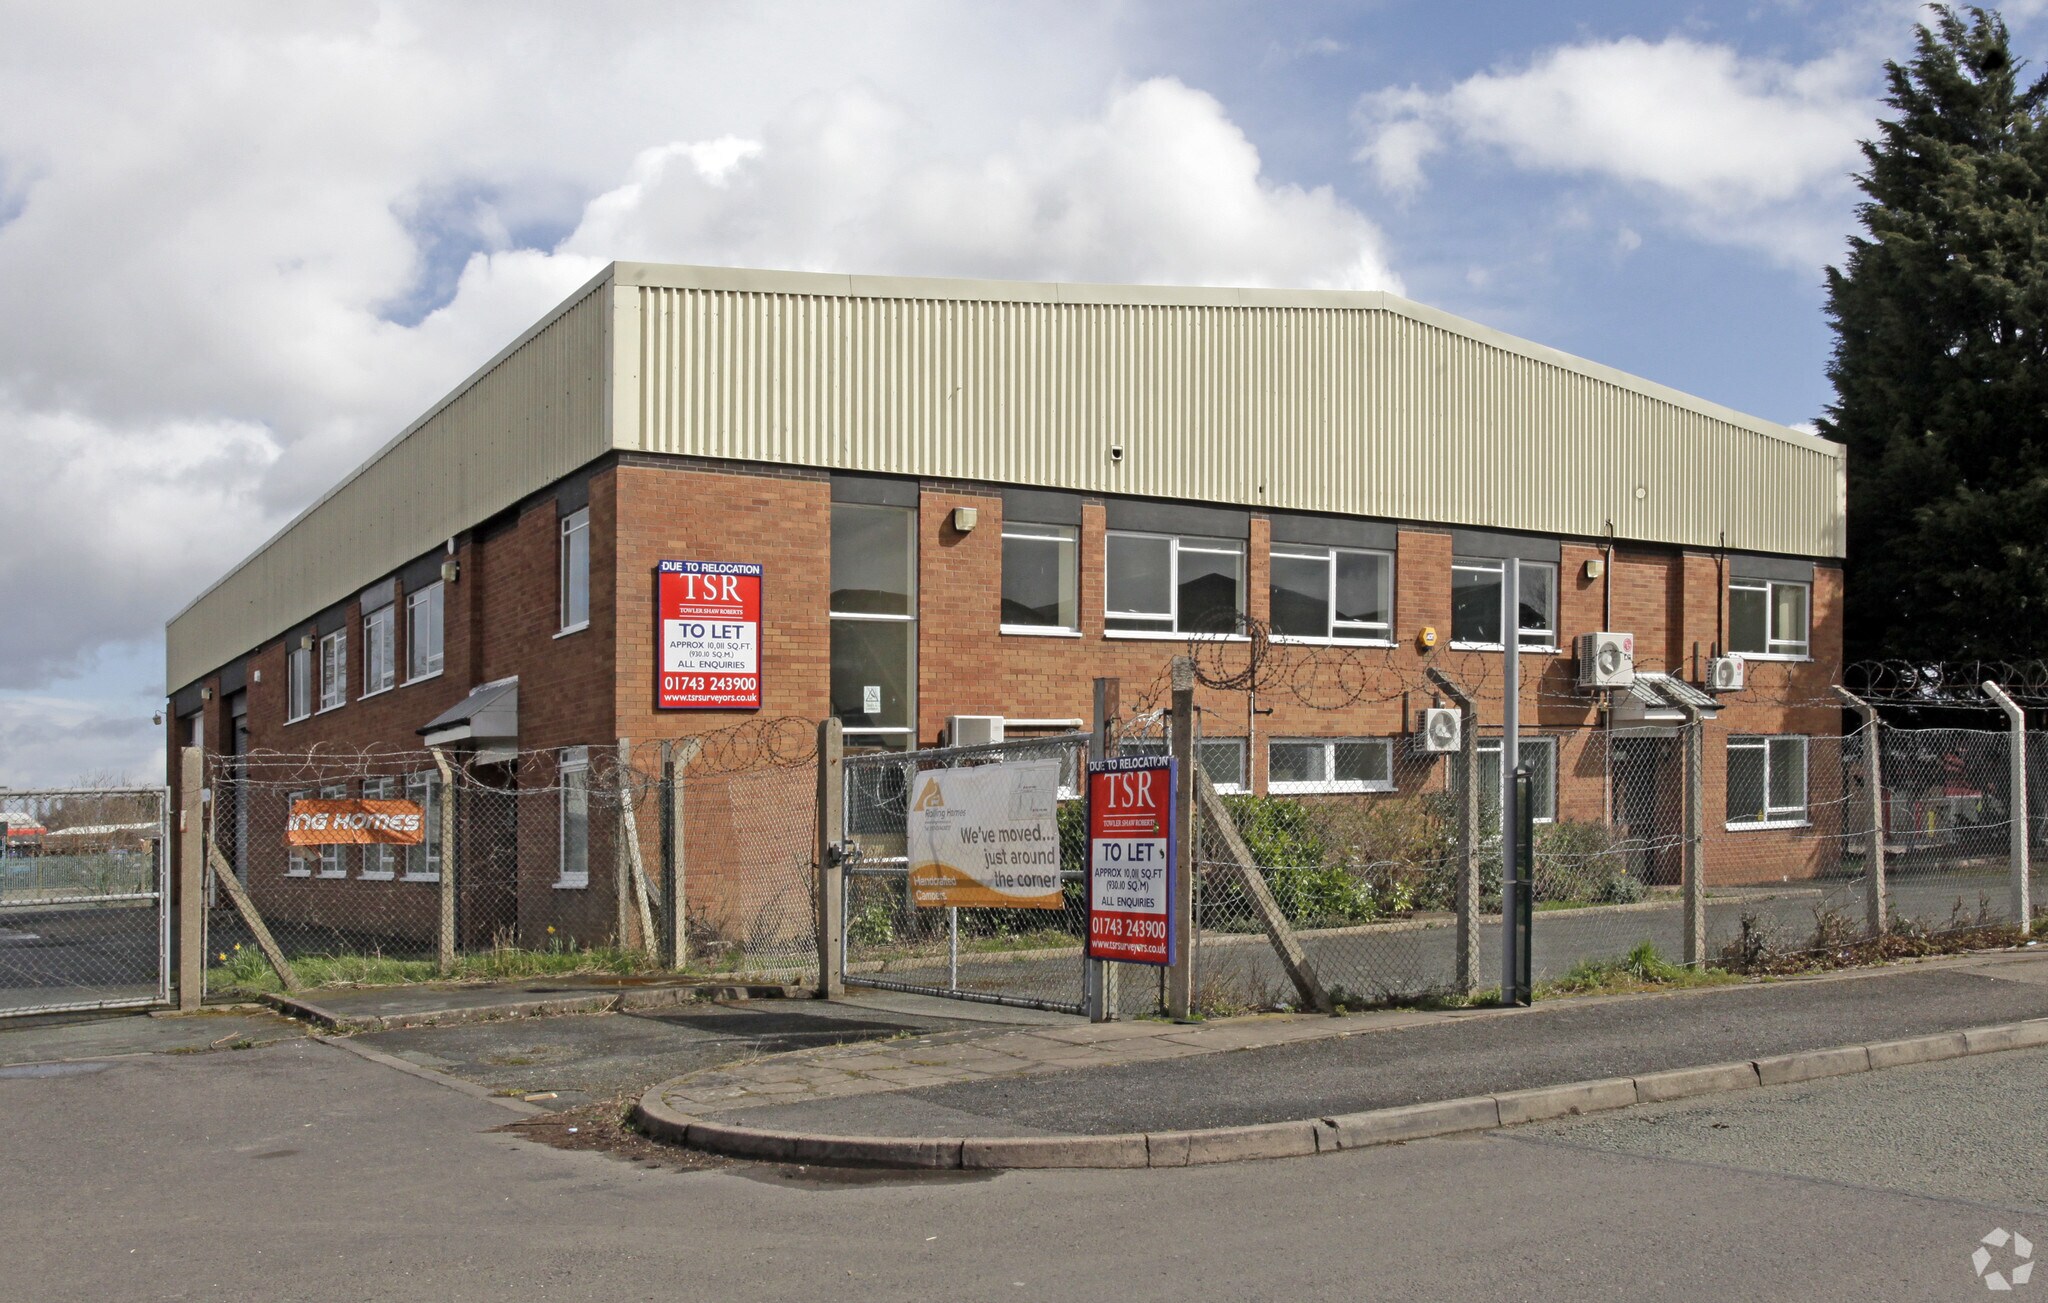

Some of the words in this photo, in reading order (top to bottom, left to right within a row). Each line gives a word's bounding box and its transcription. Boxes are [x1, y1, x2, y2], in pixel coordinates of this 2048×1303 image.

[662, 562, 682, 571] DUE
[686, 563, 699, 572] TO
[702, 564, 759, 574] RELOCATION
[680, 573, 743, 602] TSR
[679, 623, 705, 638] TO
[712, 625, 744, 639] LET
[670, 641, 704, 649] APPROX
[728, 643, 752, 651] SQ.FT.
[699, 661, 745, 669] ENQUIRIES
[665, 677, 704, 690] 01743
[710, 677, 756, 690] 243900
[664, 693, 756, 703] www.tsrsurveyors.co.uk
[1090, 761, 1105, 771] DUE
[1107, 760, 1117, 770] TO
[1120, 756, 1168, 770] RELOCATION
[1104, 771, 1155, 808] TSR
[961, 826, 995, 844] We've
[984, 849, 1006, 869] just
[1012, 847, 1054, 864] around
[1102, 843, 1121, 861] TO
[1128, 843, 1154, 861] LET
[995, 871, 1013, 887] the
[1018, 875, 1056, 887] corner
[1095, 869, 1121, 877] APPROX
[914, 876, 956, 886] Handcrafted
[1102, 896, 1114, 906] ALL
[1117, 897, 1154, 908] ENQUIRIES
[1092, 918, 1122, 936] 01743
[1126, 919, 1165, 939] 243900
[1092, 940, 1165, 954] www.tsrsurveyors.co.uk
